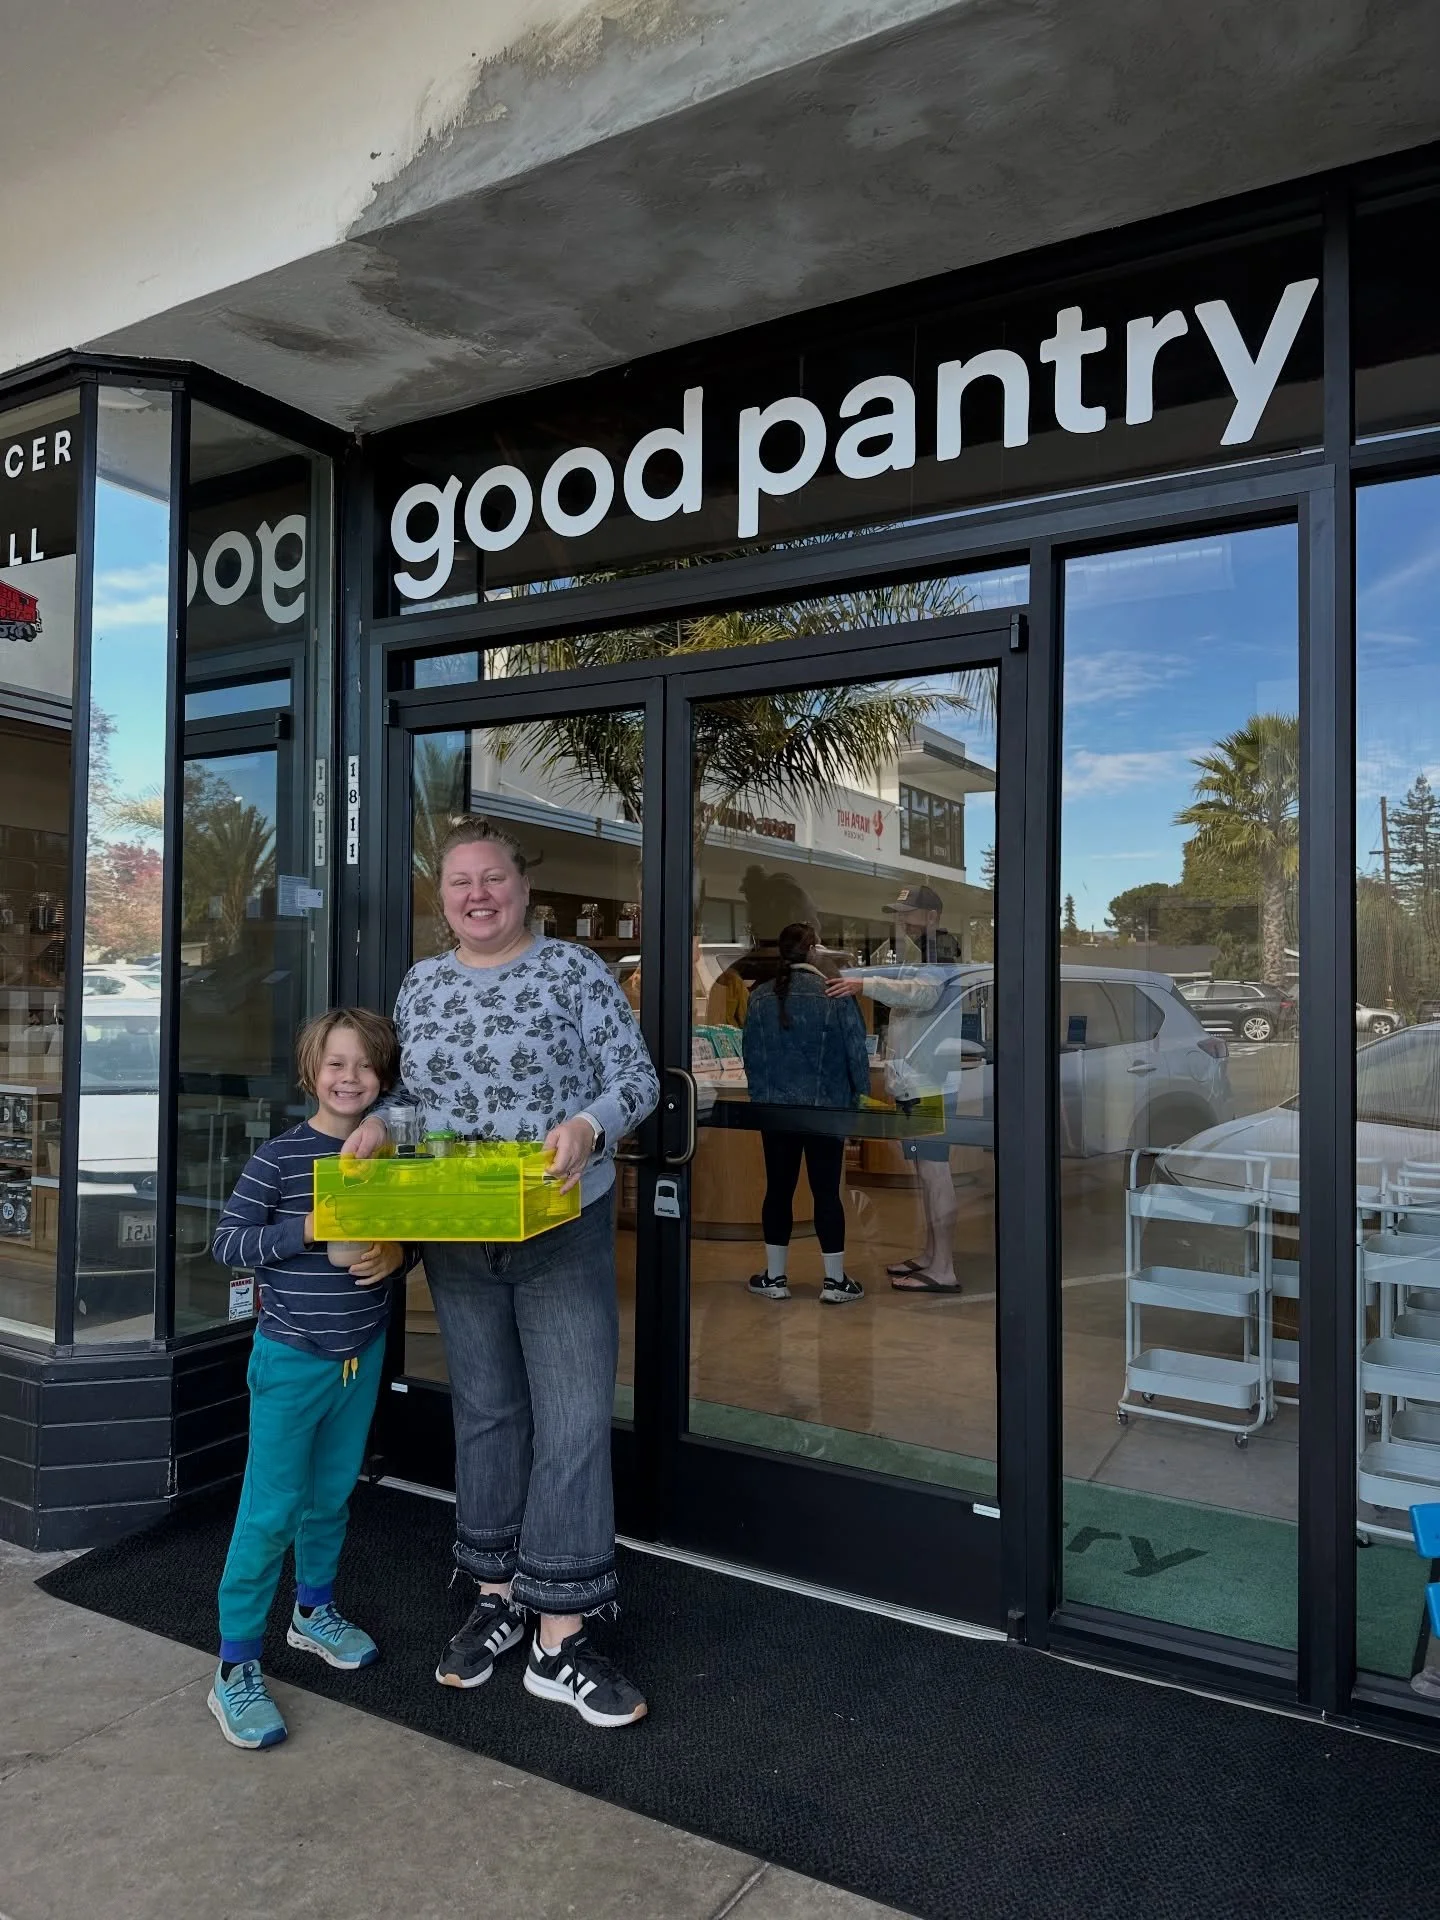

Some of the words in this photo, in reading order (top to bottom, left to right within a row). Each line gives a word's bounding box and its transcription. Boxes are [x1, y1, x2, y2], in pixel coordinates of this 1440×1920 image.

[4, 430, 71, 478] CER
[391, 387, 703, 599] good
[738, 279, 1318, 538] pantry
[9, 527, 44, 567] LL
[348, 761, 358, 859] 1811
[1063, 1522, 1209, 1578] ry
